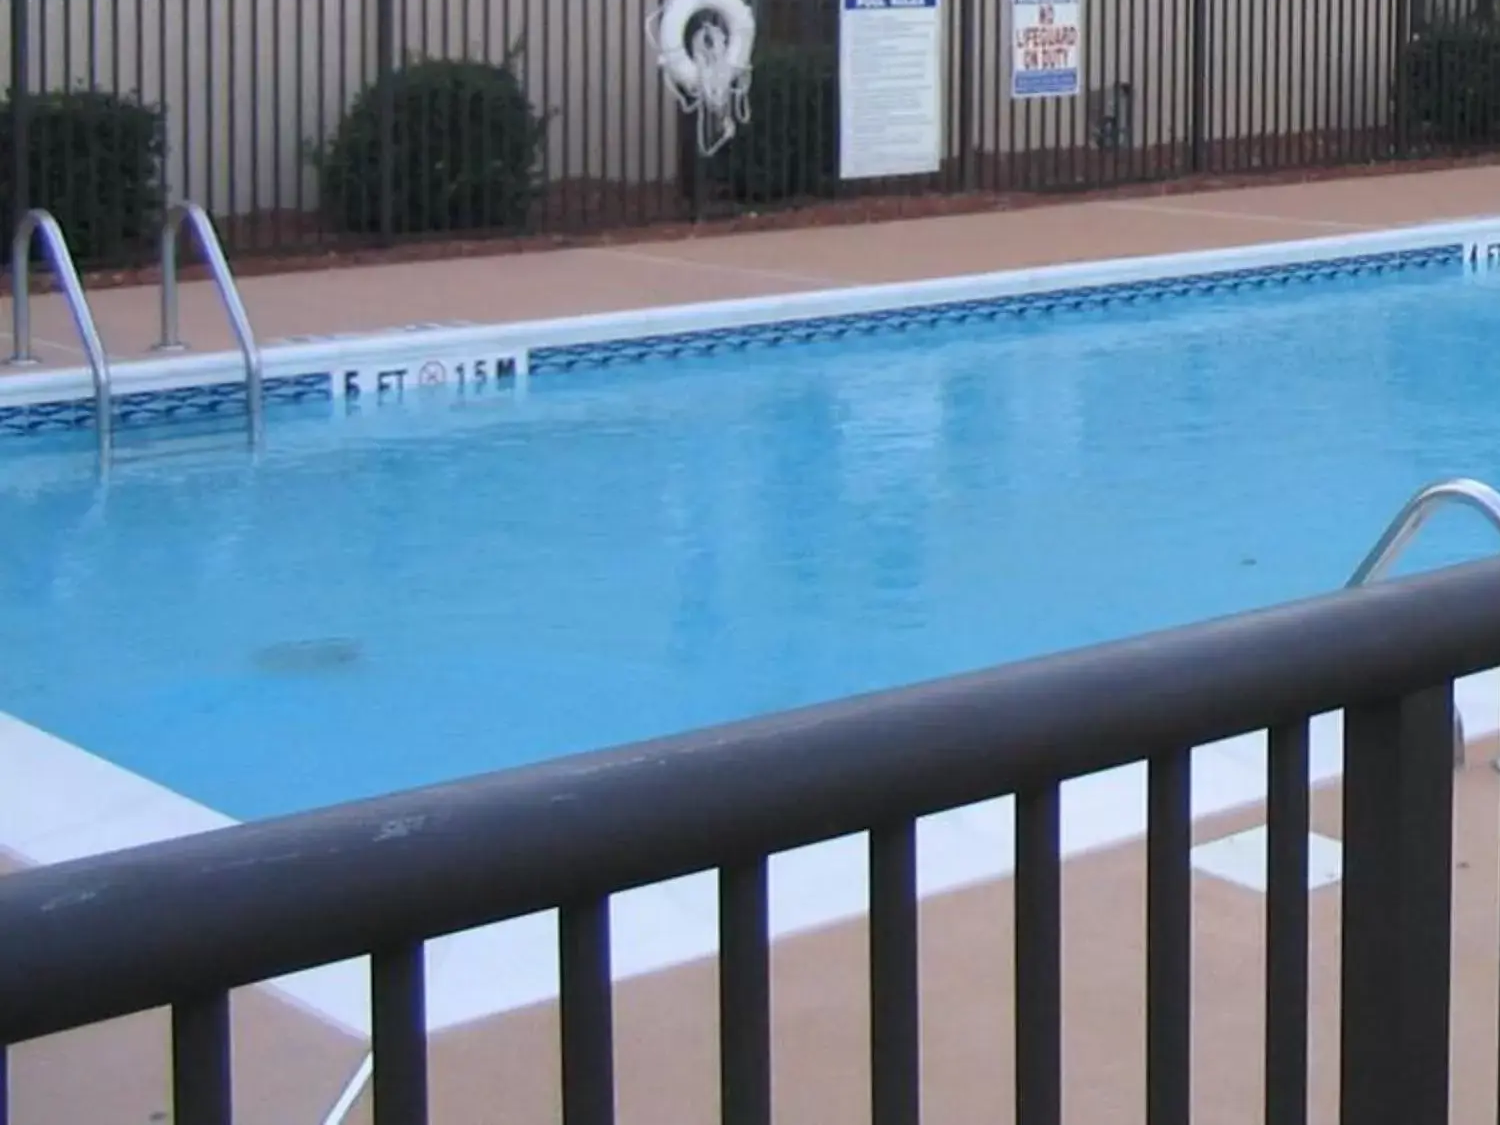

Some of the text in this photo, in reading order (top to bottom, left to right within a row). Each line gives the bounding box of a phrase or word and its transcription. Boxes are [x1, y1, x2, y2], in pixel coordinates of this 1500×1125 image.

[1038, 4, 1055, 24] NO
[1016, 26, 1078, 49] LIFEGUARD
[1023, 48, 1069, 70] ON DUTY
[345, 370, 360, 398] 5
[377, 369, 408, 392] FT
[496, 357, 516, 380] M
